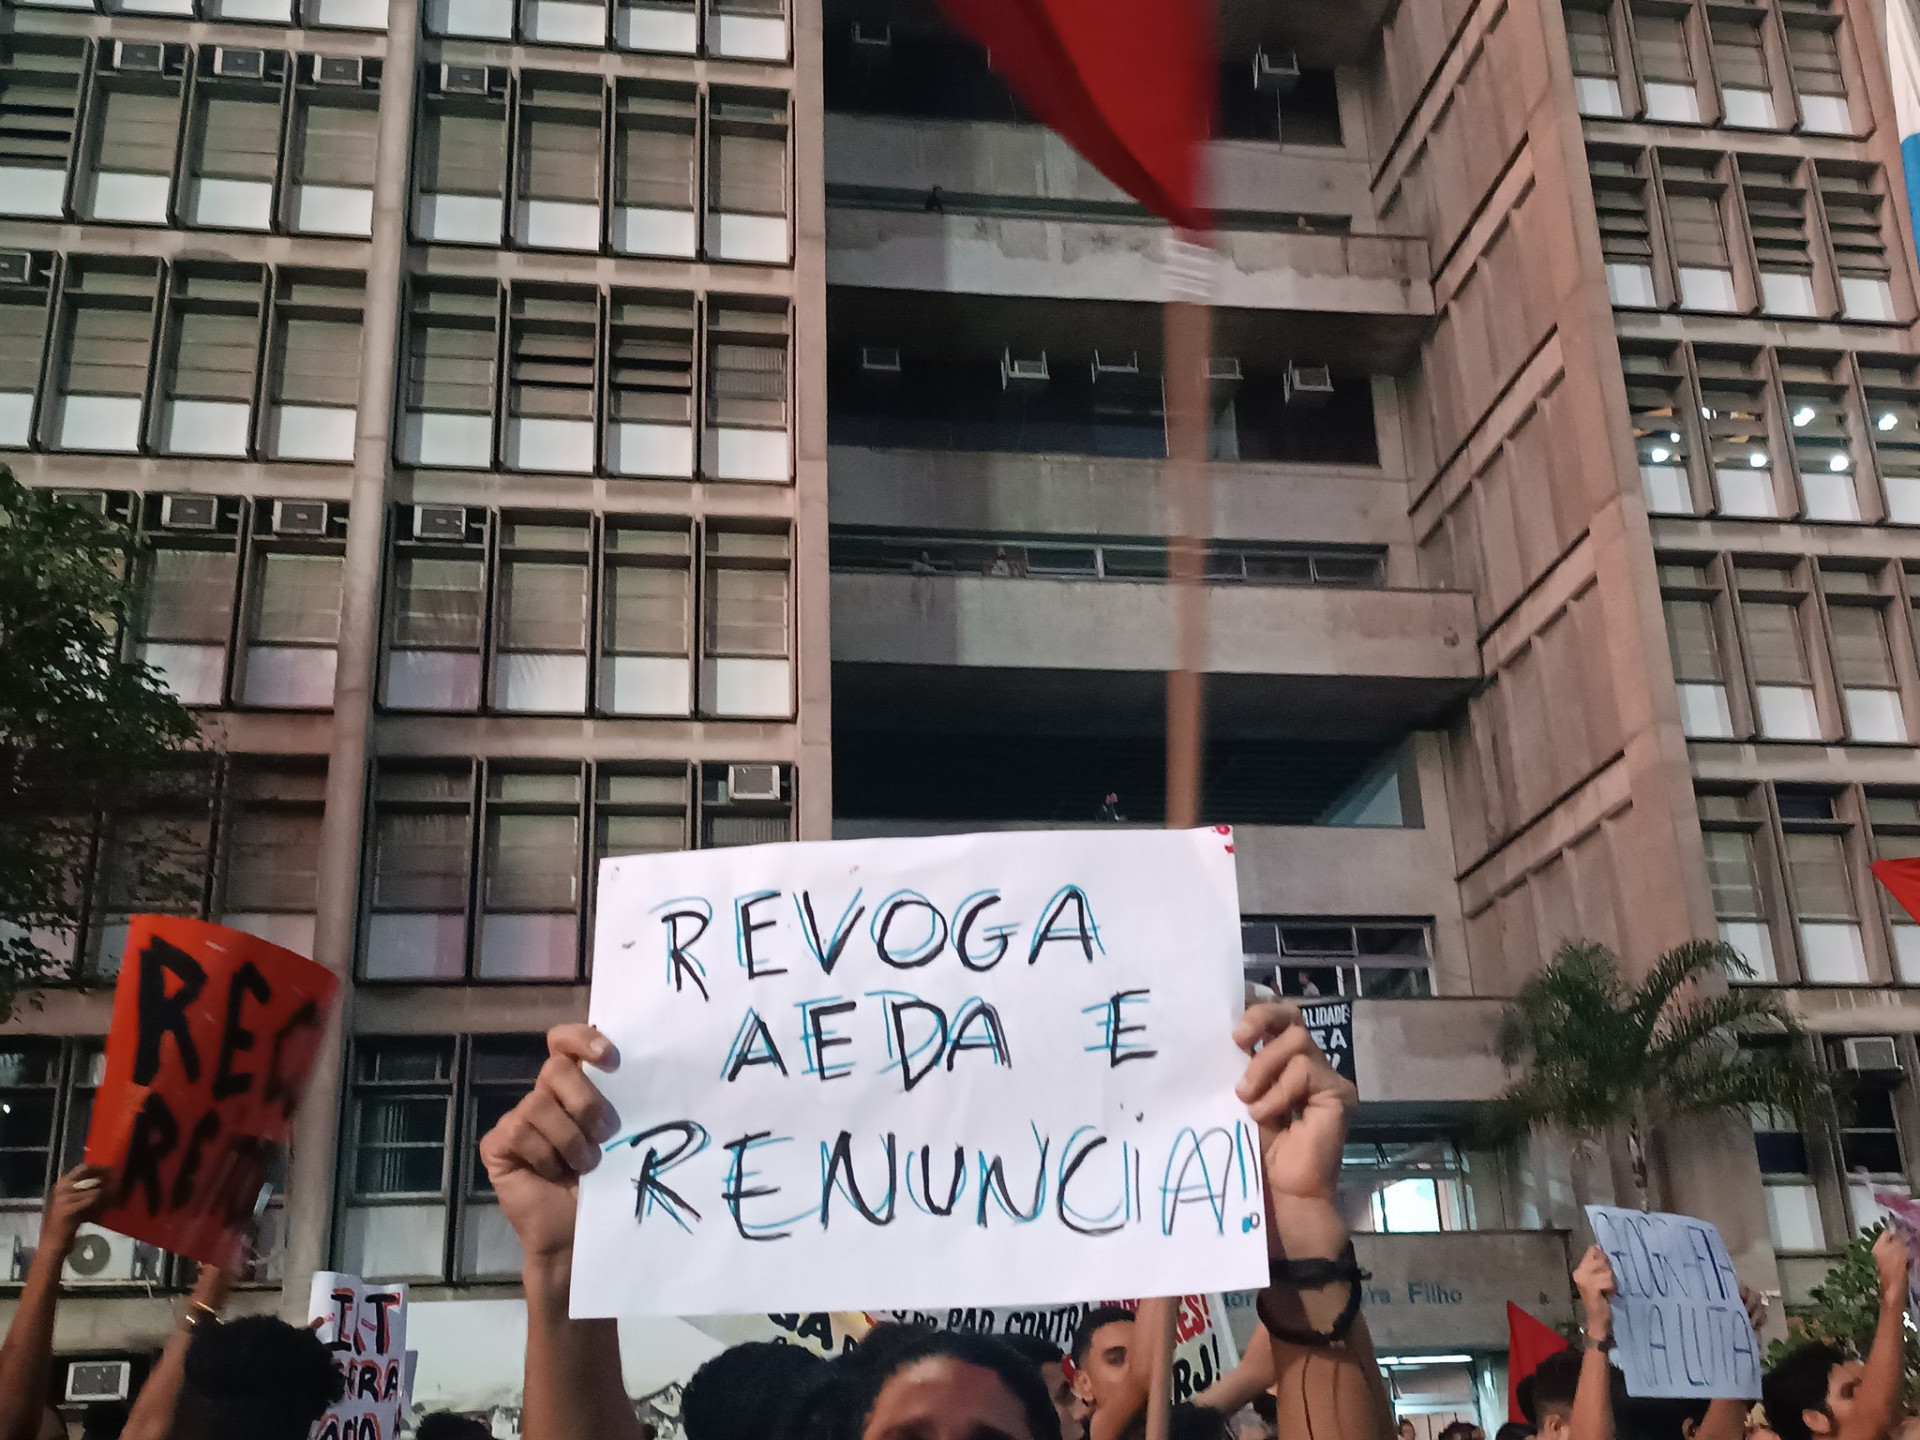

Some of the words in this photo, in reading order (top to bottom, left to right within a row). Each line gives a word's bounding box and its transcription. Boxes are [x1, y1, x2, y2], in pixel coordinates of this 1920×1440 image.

[649, 885, 1106, 1002] REVOGA
[719, 989, 1012, 1092] AEDA
[1081, 988, 1159, 1068] E
[1407, 1281, 1464, 1305] Filho
